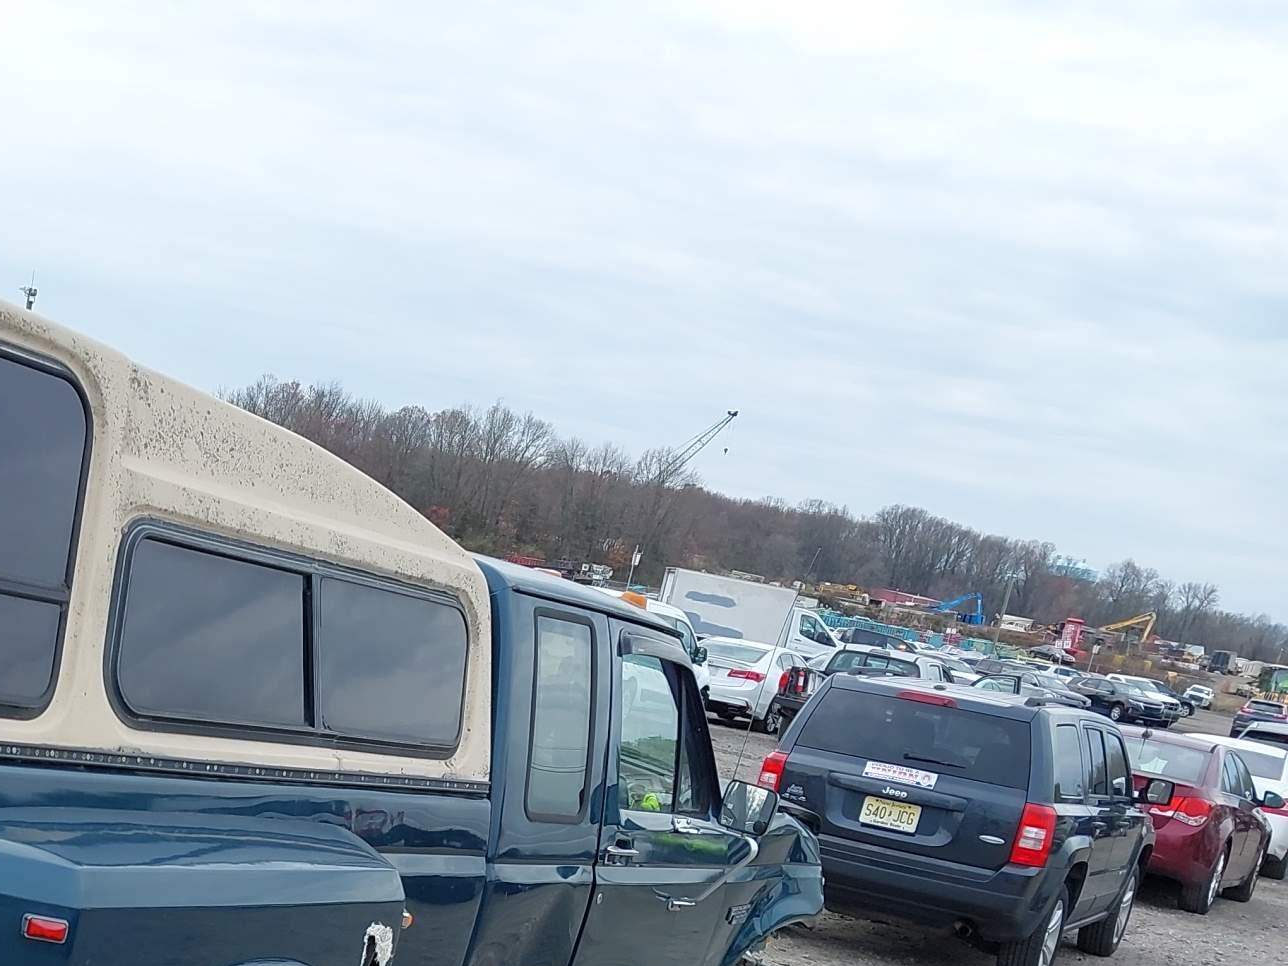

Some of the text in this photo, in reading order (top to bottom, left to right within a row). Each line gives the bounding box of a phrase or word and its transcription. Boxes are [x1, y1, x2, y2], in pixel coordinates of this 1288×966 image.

[881, 786, 908, 798] Jeep
[864, 803, 916, 826] S40 JCG
